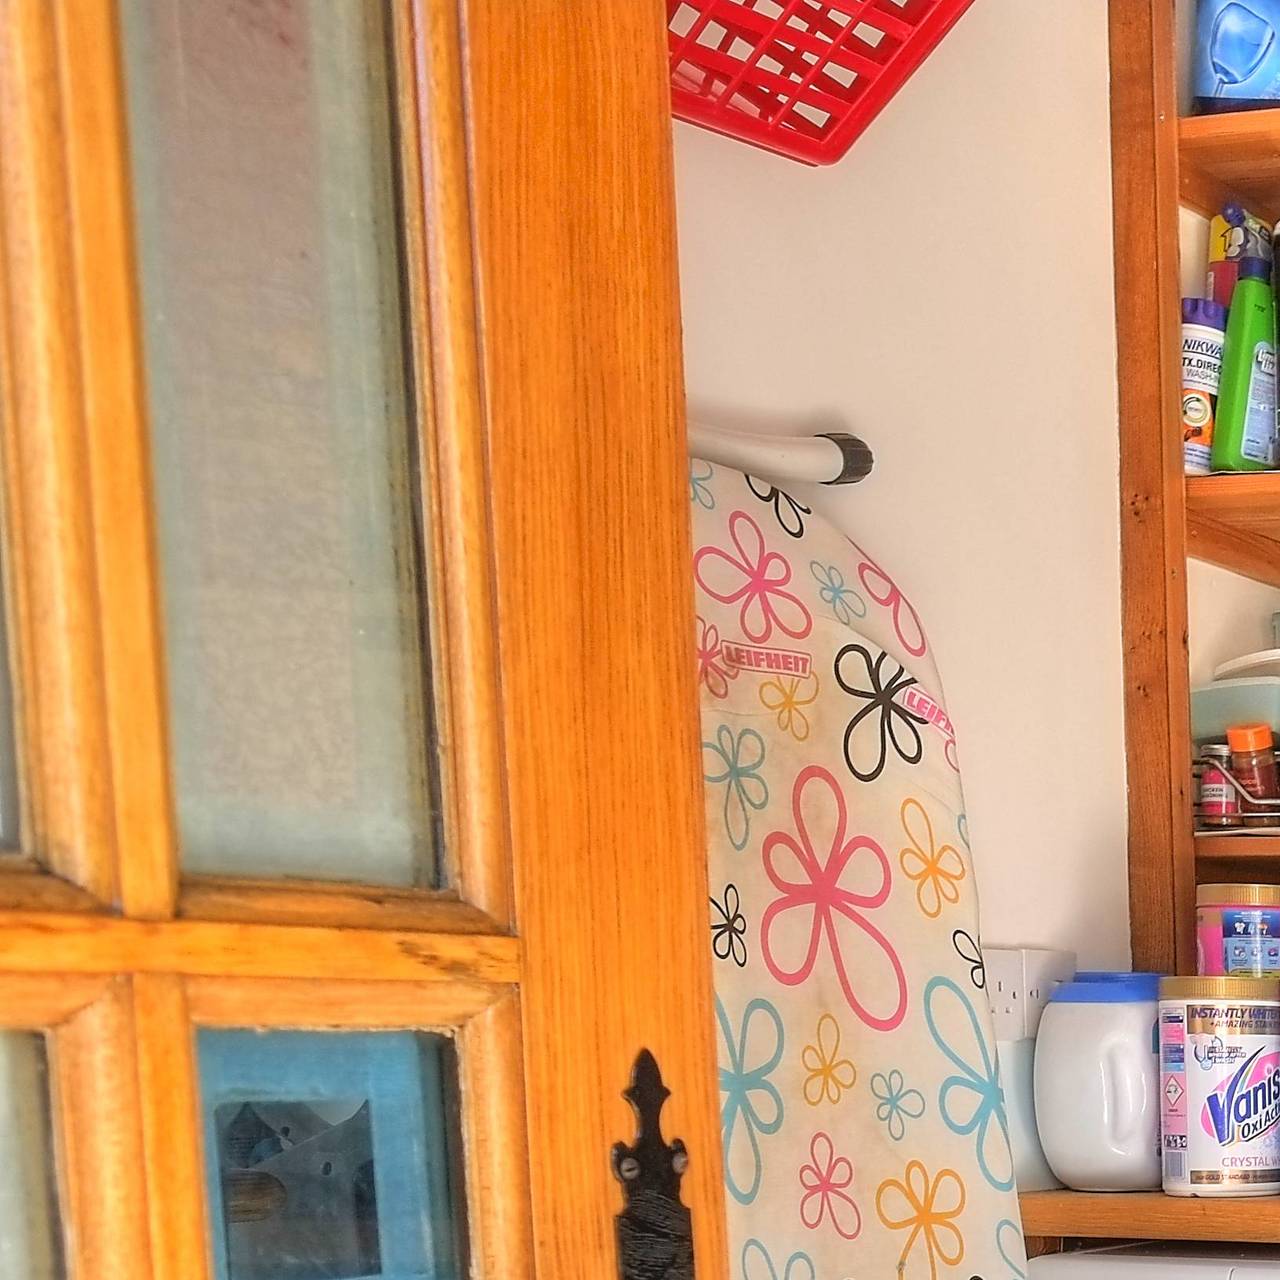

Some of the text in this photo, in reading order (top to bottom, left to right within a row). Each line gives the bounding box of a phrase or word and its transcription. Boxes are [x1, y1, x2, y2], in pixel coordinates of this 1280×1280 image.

[1186, 370, 1220, 383] WASH-
[725, 643, 811, 675] LEIFHEIT
[1191, 1007, 1248, 1019] INSTANTLY
[1221, 1155, 1269, 1168] CRYSTAL
